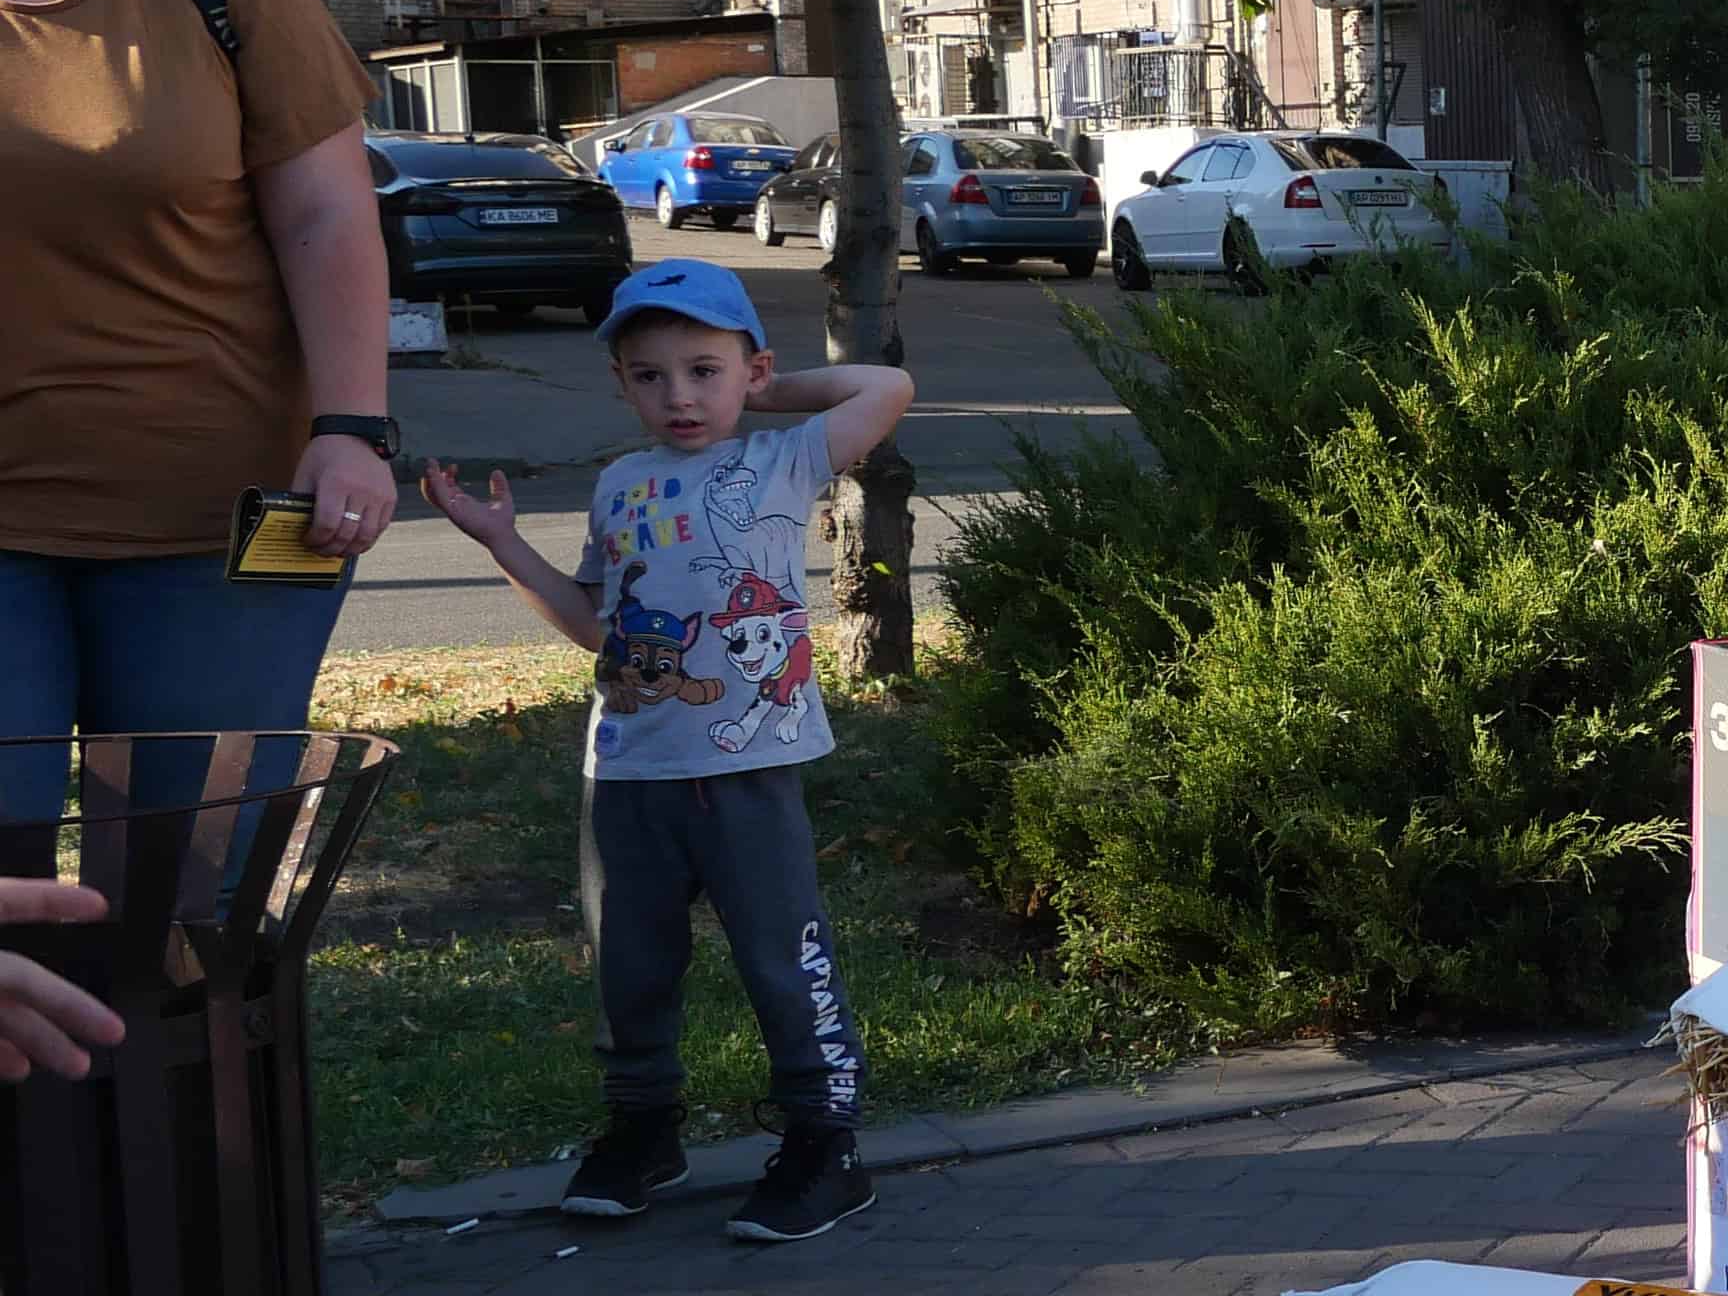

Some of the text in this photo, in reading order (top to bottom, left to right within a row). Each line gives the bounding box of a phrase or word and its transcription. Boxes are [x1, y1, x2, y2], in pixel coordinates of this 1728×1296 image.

[611, 477, 681, 516] BOLD
[626, 503, 658, 523] AND
[604, 509, 693, 566] BRAVE
[800, 919, 843, 1037] CAPTAIN
